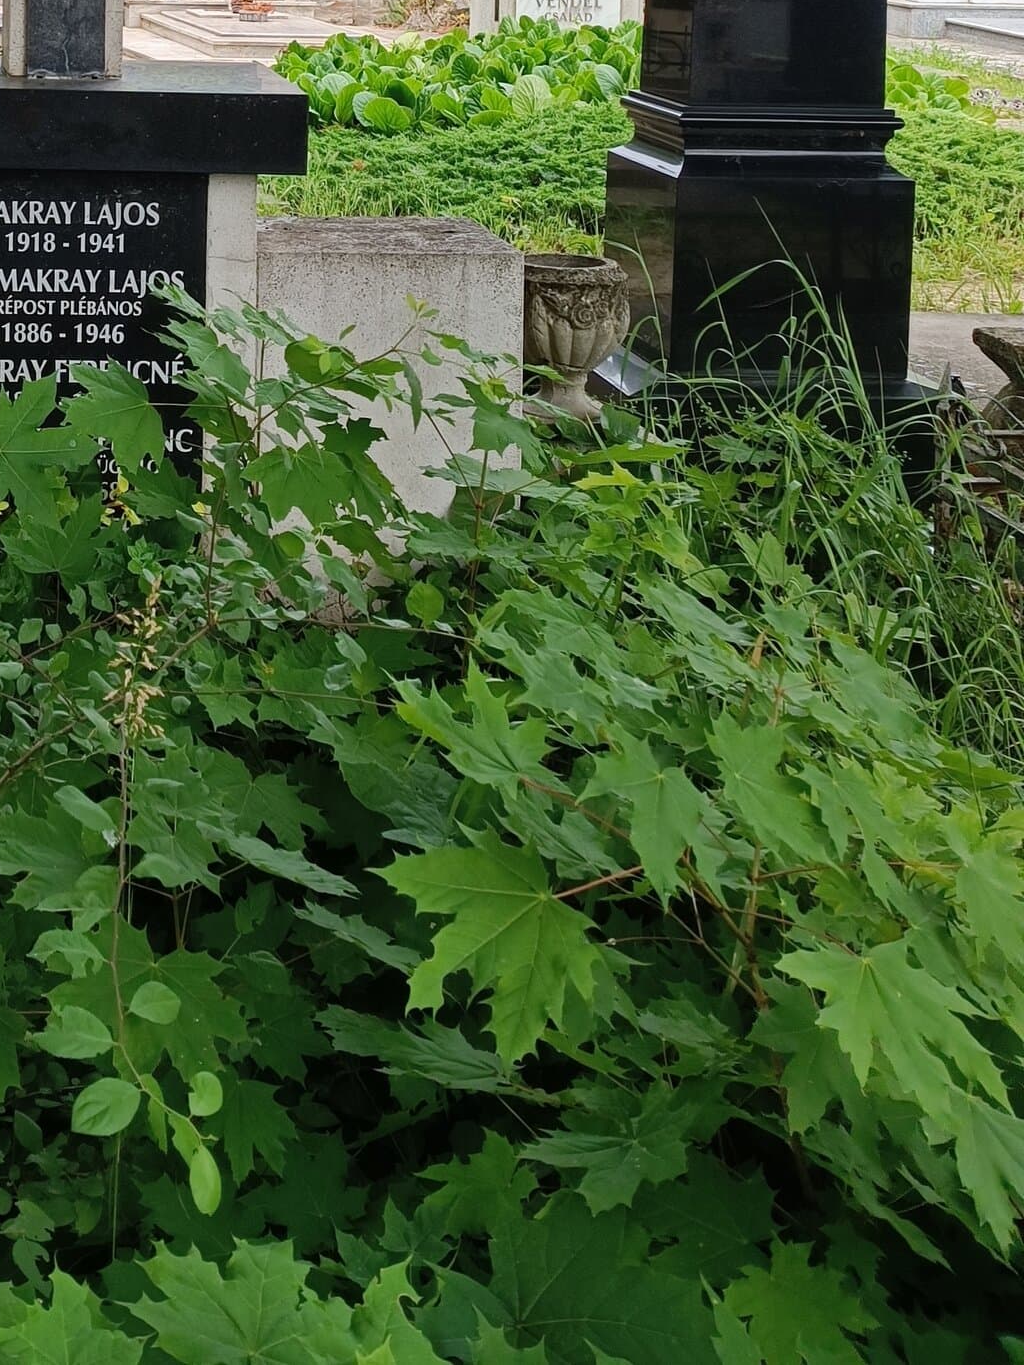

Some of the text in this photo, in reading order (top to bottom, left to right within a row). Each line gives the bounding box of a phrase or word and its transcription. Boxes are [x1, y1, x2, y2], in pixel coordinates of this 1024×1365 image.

[84, 201, 161, 230] LAJOS
[4, 232, 56, 253] 1918
[77, 233, 125, 253] 1941
[109, 269, 185, 298] LAJOS
[60, 296, 143, 316] PLÉBÁNOS
[0, 322, 53, 343] 1886
[73, 323, 125, 344] 1946
[54, 353, 185, 384] FECNÉ
